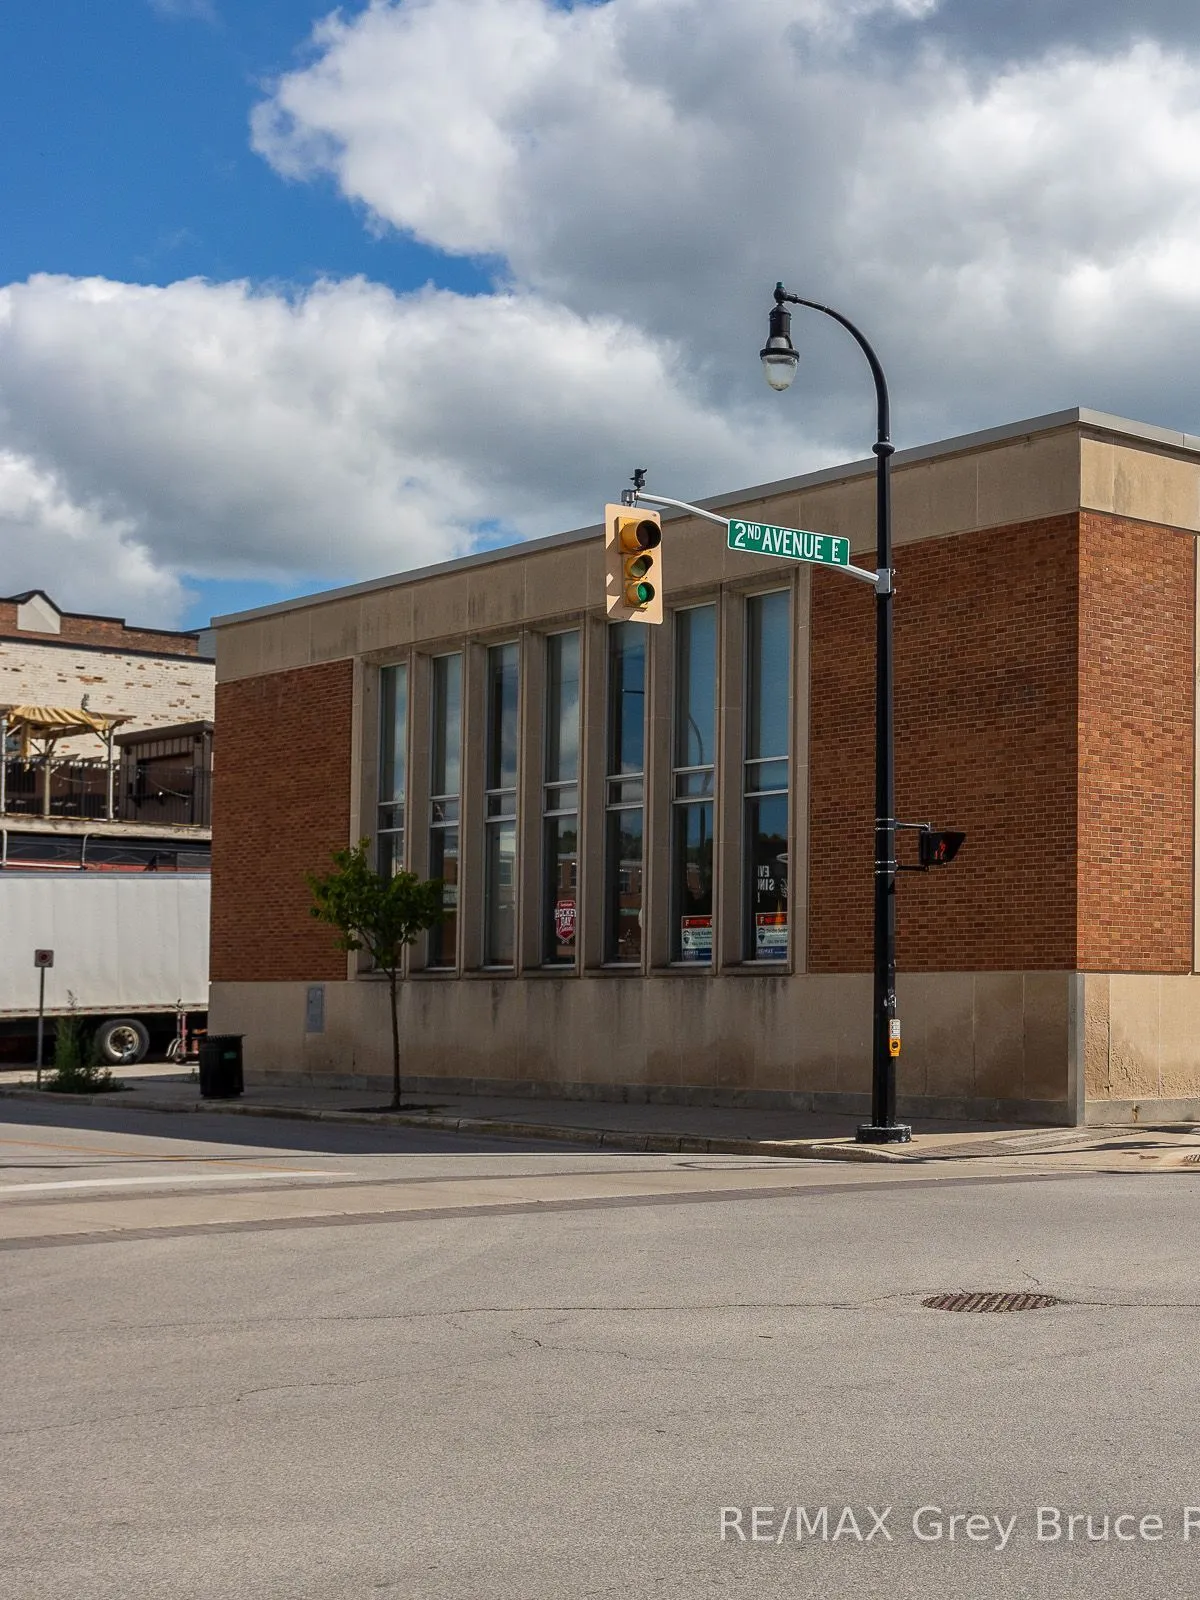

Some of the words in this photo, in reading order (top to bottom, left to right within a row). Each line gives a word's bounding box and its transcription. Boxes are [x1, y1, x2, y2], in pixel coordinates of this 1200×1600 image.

[734, 522, 761, 548] 2ND
[762, 527, 824, 560] AVENUE
[831, 538, 841, 563] E
